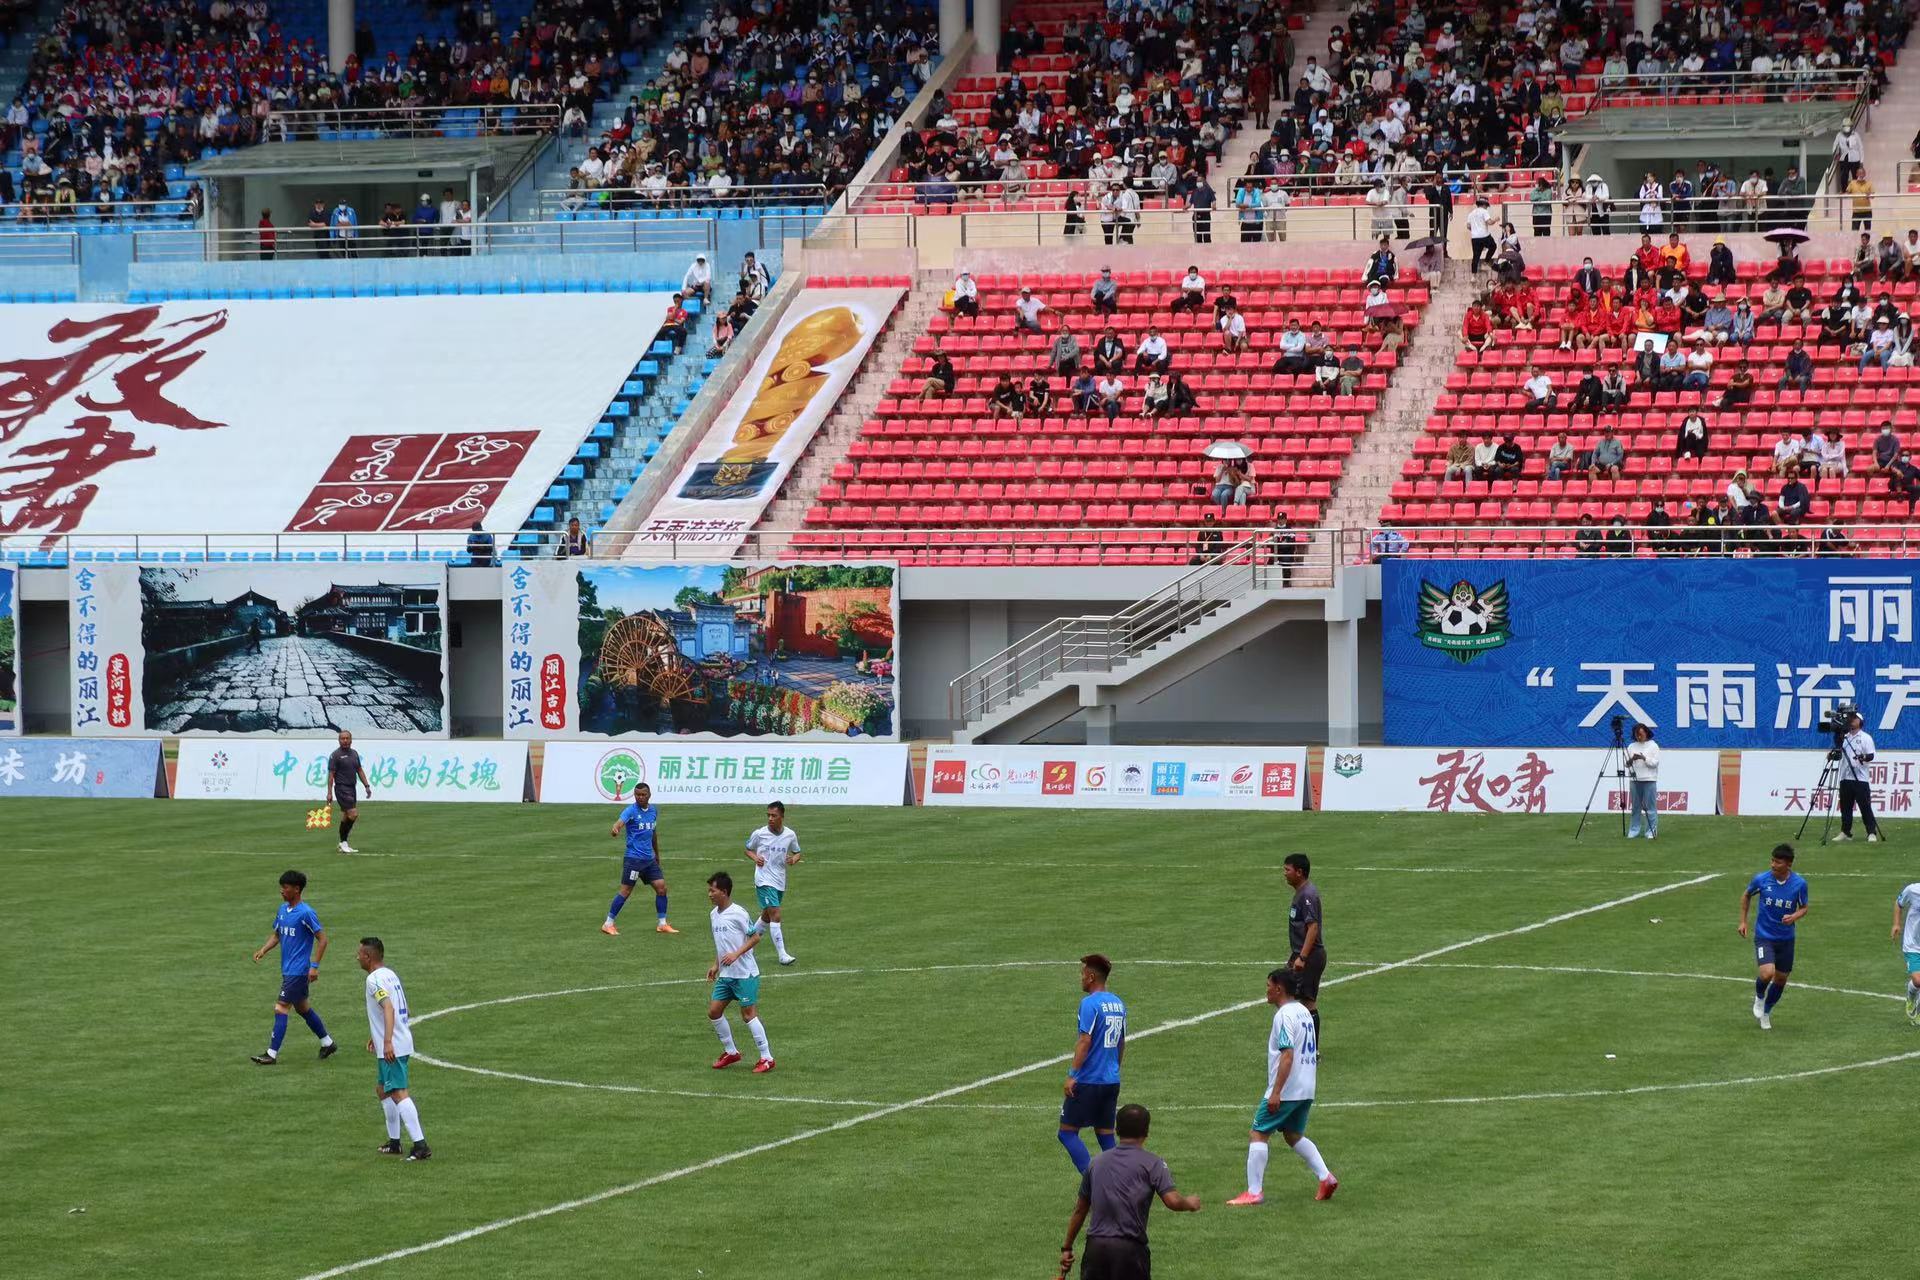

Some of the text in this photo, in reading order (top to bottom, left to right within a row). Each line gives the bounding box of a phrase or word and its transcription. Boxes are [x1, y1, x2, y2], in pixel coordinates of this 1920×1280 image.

[75, 567, 101, 728] 舍不得的丽江
[508, 565, 534, 730] 舍不得的丽江
[545, 659, 561, 726] 丽江古城
[273, 750, 501, 792] 中国好的玫瑰
[658, 755, 852, 781] 丽江市足球协会
[1868, 762, 1920, 785] 丽江
[657, 785, 849, 794] LIJIANG FOOTBALL ASSOCIATION
[1770, 787, 1920, 811] “天雨芳杯
